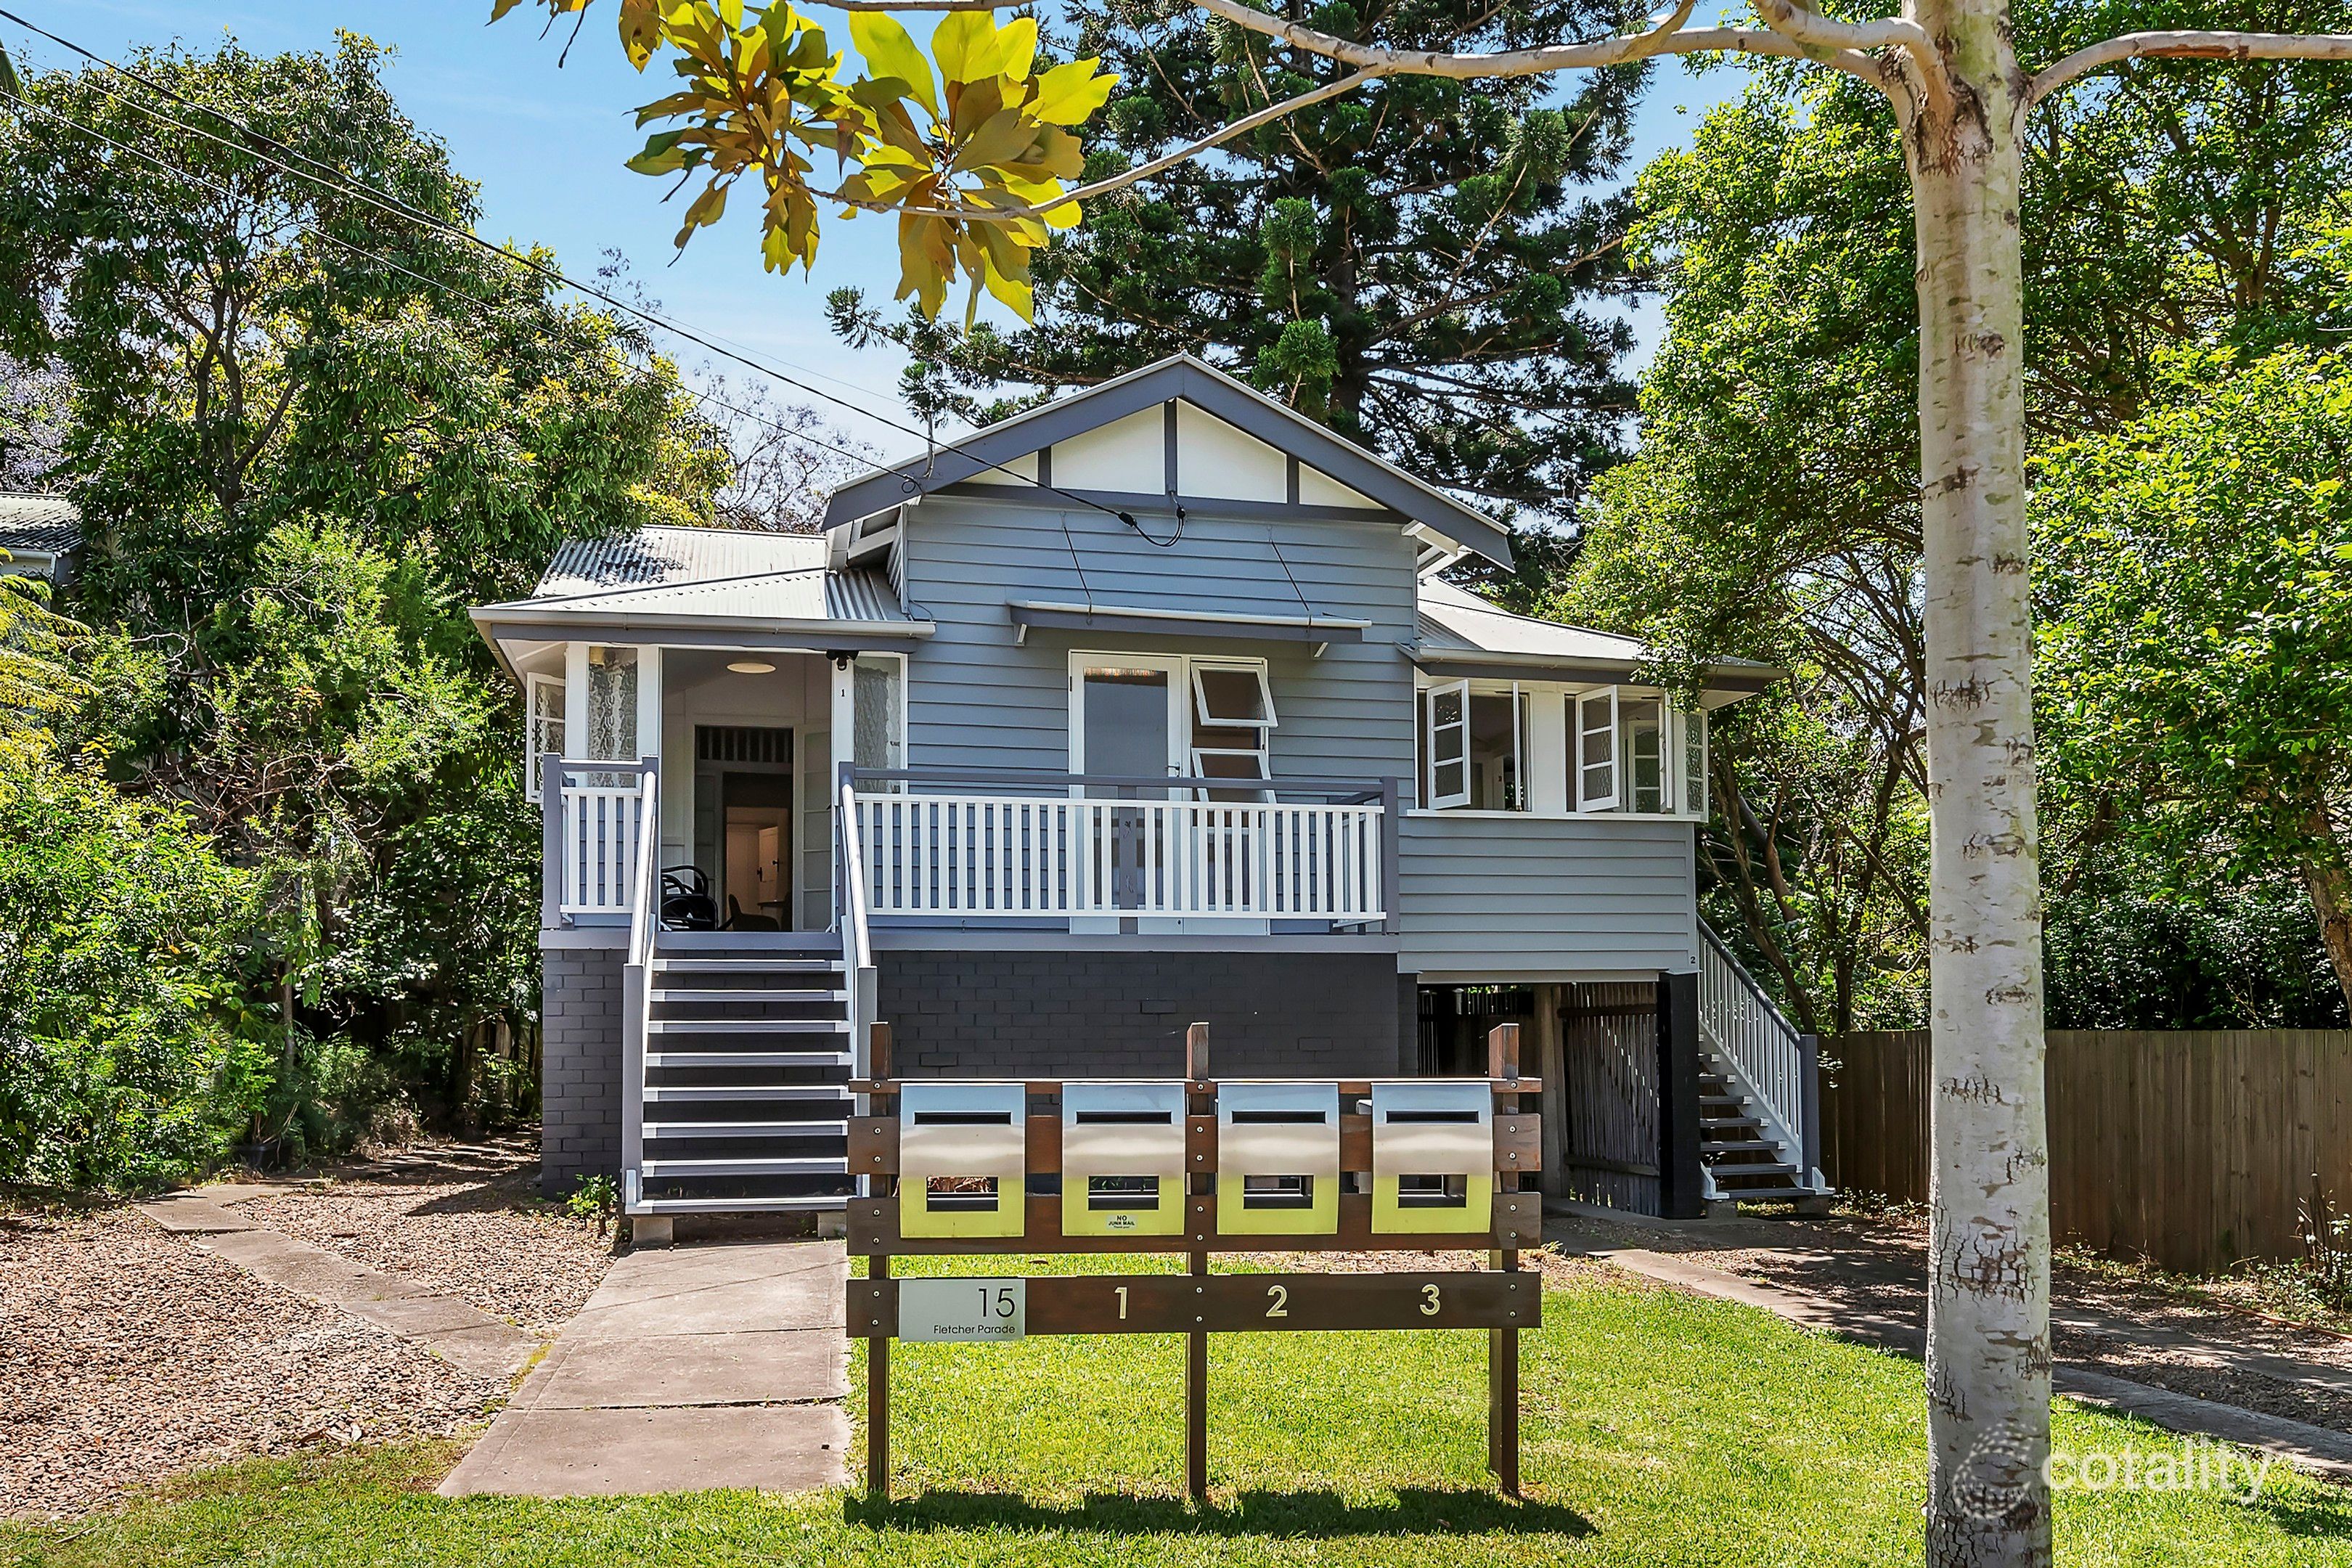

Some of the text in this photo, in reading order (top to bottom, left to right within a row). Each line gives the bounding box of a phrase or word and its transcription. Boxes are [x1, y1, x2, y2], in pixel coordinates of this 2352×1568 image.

[978, 1287, 1016, 1318] 15
[1114, 1286, 1127, 1320] 1
[1265, 1284, 1288, 1318] 2
[1419, 1283, 1441, 1315] 3
[933, 1324, 1016, 1334] Fletcher Parade
